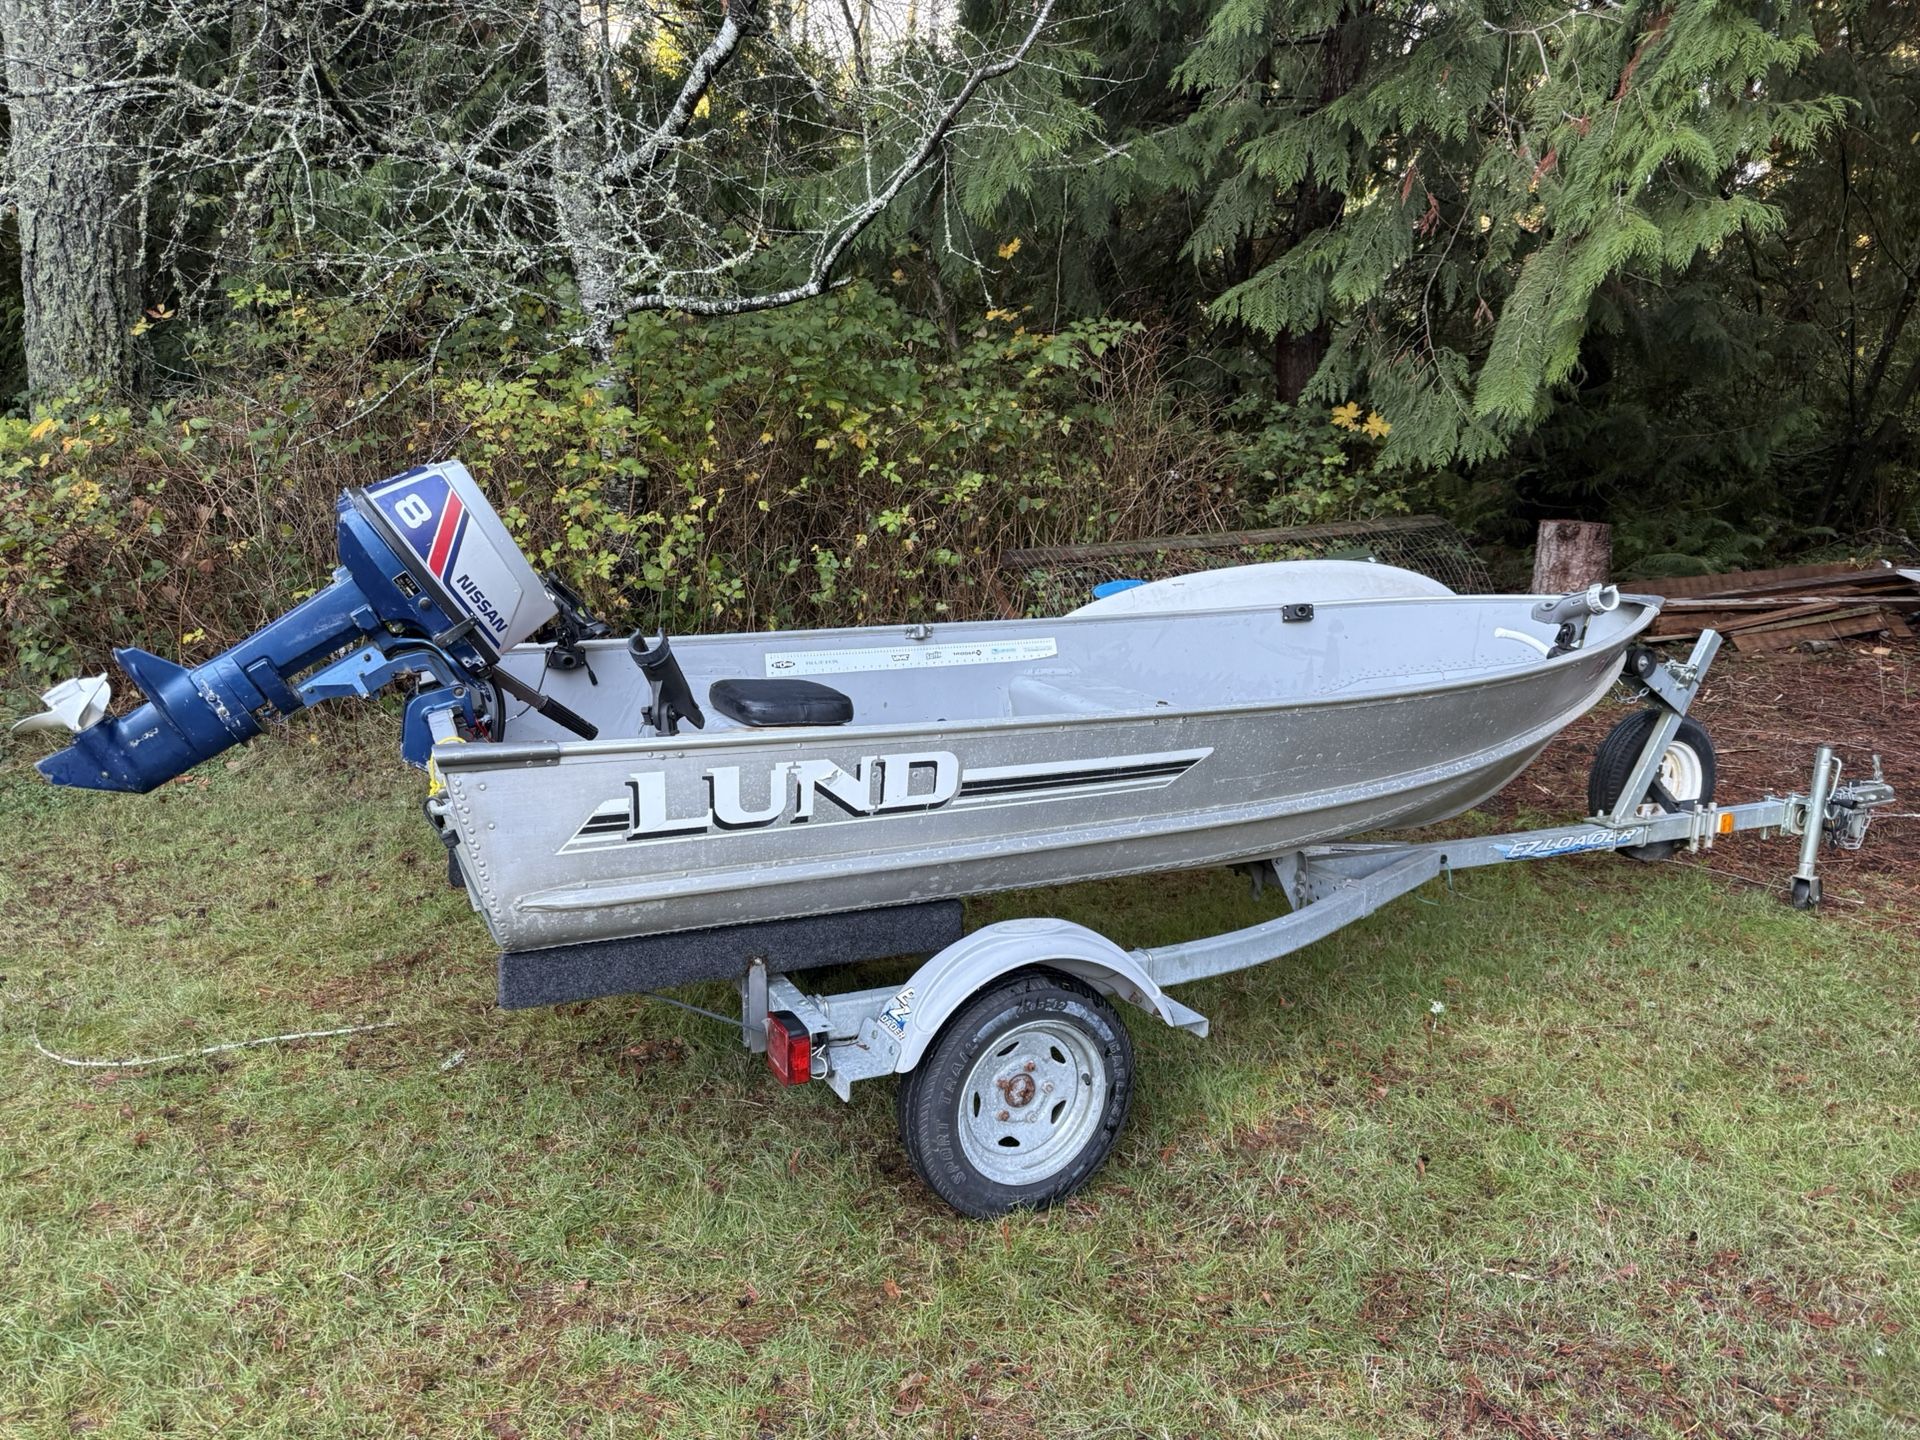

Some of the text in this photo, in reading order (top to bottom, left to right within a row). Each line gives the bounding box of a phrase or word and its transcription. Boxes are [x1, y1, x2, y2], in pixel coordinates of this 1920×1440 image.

[394, 493, 432, 529] 8
[456, 573, 508, 633] NISSAN
[625, 750, 962, 841] LUND
[935, 1119, 968, 1185] SPORT
